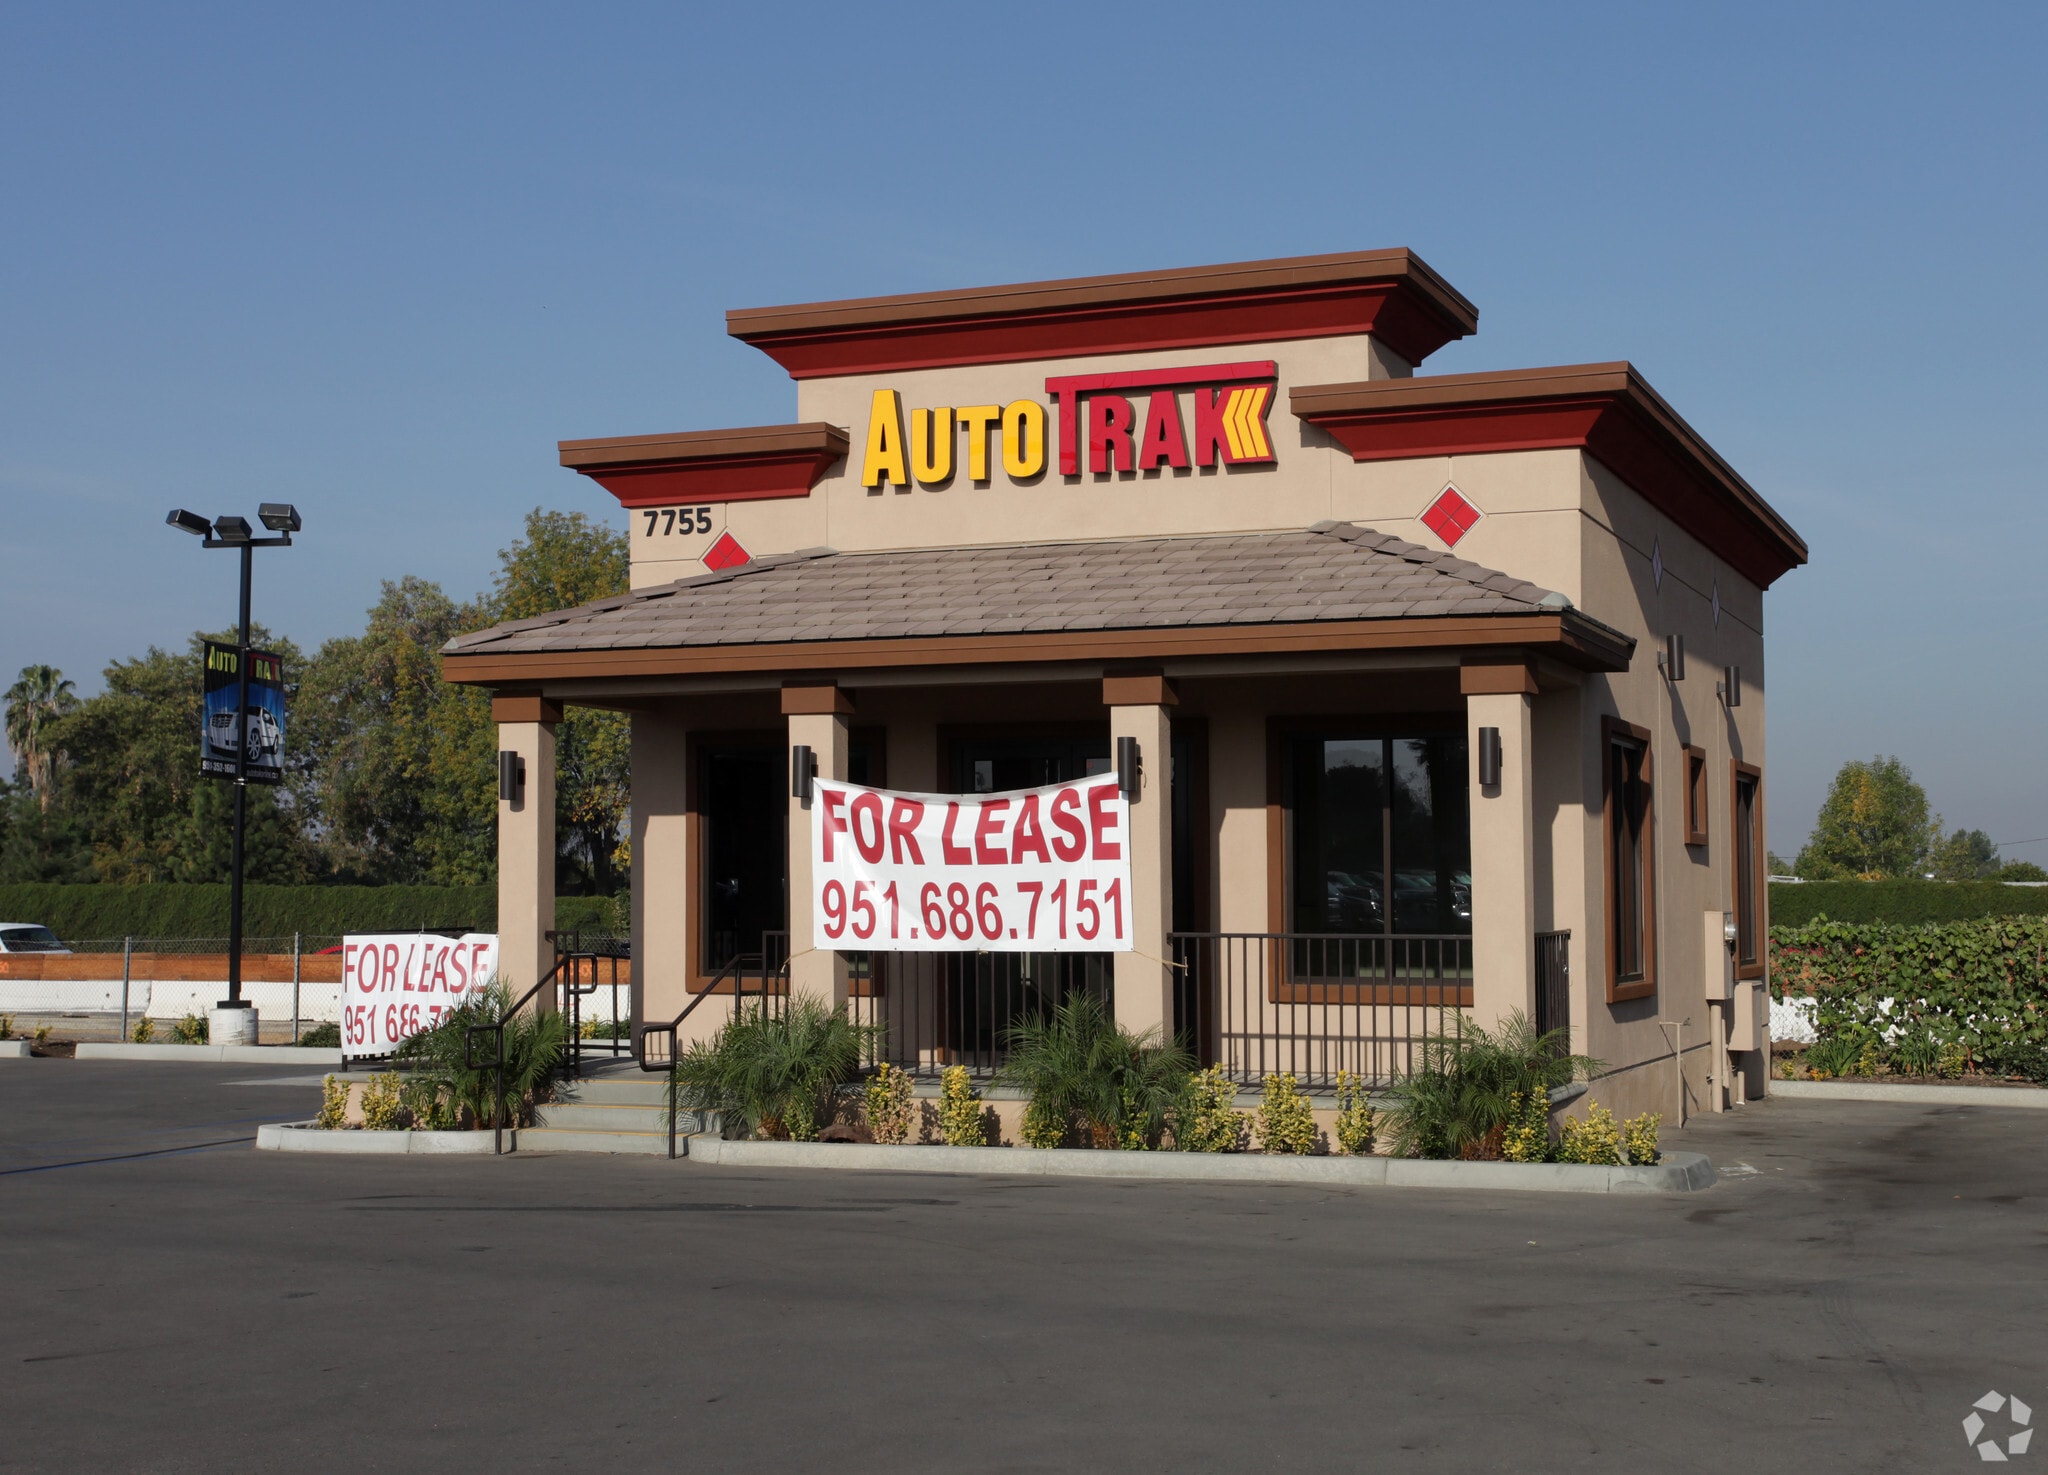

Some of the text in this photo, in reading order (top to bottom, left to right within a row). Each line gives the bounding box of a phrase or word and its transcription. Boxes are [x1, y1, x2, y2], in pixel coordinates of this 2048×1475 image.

[643, 507, 712, 537] 7755
[207, 645, 238, 674] AUTO
[822, 783, 1121, 866] FOR LEASE
[822, 877, 1124, 941] 951.686.7151
[344, 942, 490, 994] FOR LEASE
[344, 1004, 377, 1046] 951
